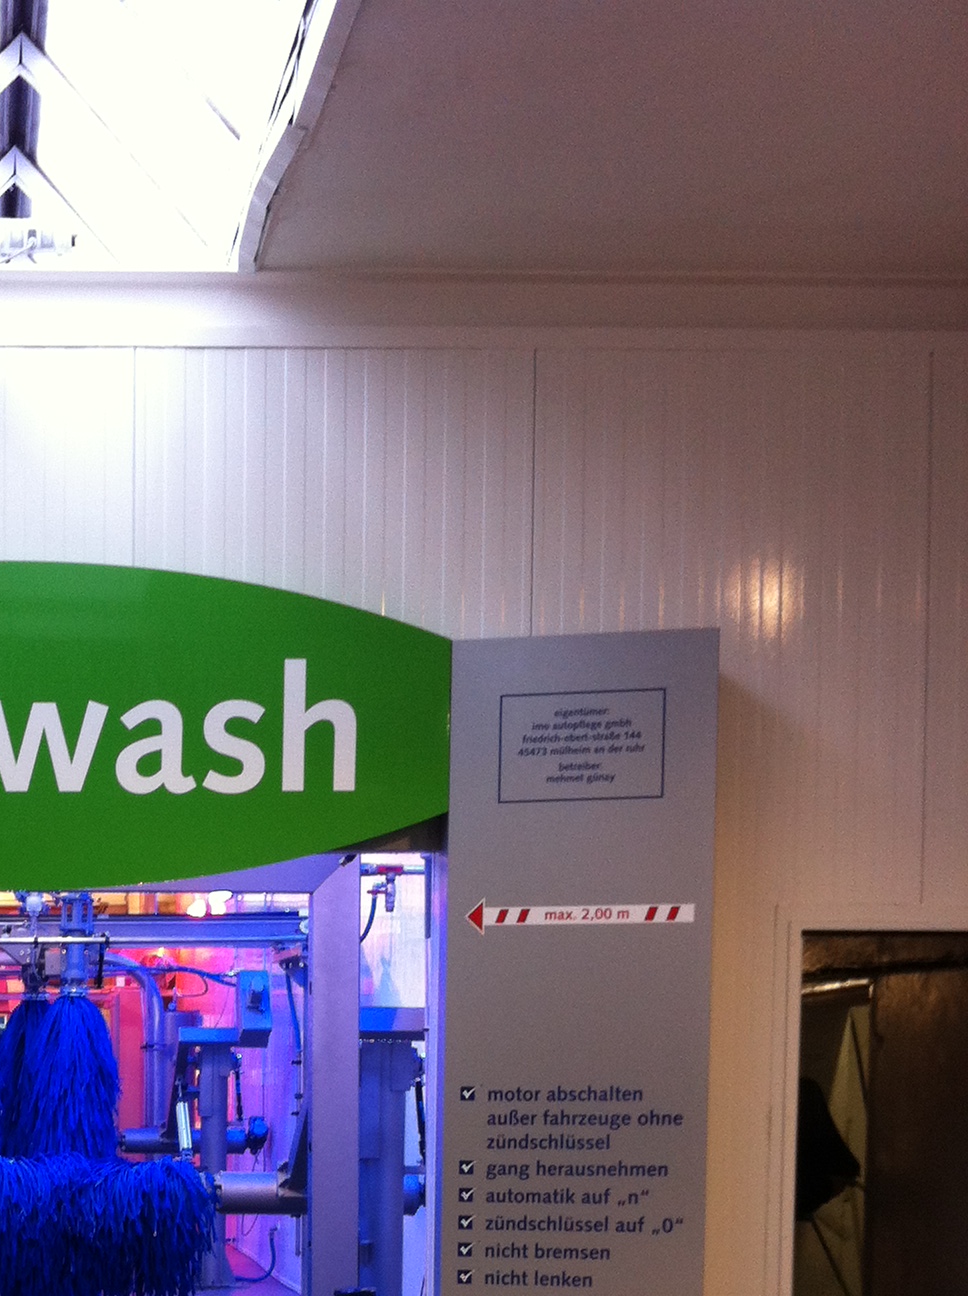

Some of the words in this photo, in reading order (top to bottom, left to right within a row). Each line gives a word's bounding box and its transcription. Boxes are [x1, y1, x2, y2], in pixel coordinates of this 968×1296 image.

[552, 720, 602, 732] autopflege
[604, 718, 632, 730] gmbh
[550, 745, 591, 756] mülheim
[544, 908, 576, 921] max.
[582, 908, 612, 921] 2,00
[617, 909, 630, 919] m
[487, 1086, 541, 1101] motor
[547, 1086, 643, 1102] abschalten
[487, 1110, 538, 1126] außer
[543, 1110, 631, 1130] fahrzeuge
[637, 1110, 684, 1126] ohne
[486, 1133, 611, 1150] zündschlüssel
[486, 1162, 530, 1180] gang
[536, 1160, 669, 1177] herausnehmen
[485, 1188, 575, 1205] automatik
[581, 1188, 611, 1205] auf
[485, 1215, 609, 1232] zündschlüssel
[615, 1216, 645, 1233] auf
[484, 1243, 529, 1259] nicht
[534, 1243, 611, 1260] bremsen
[484, 1270, 529, 1286] nicht
[534, 1270, 593, 1287] lenken
